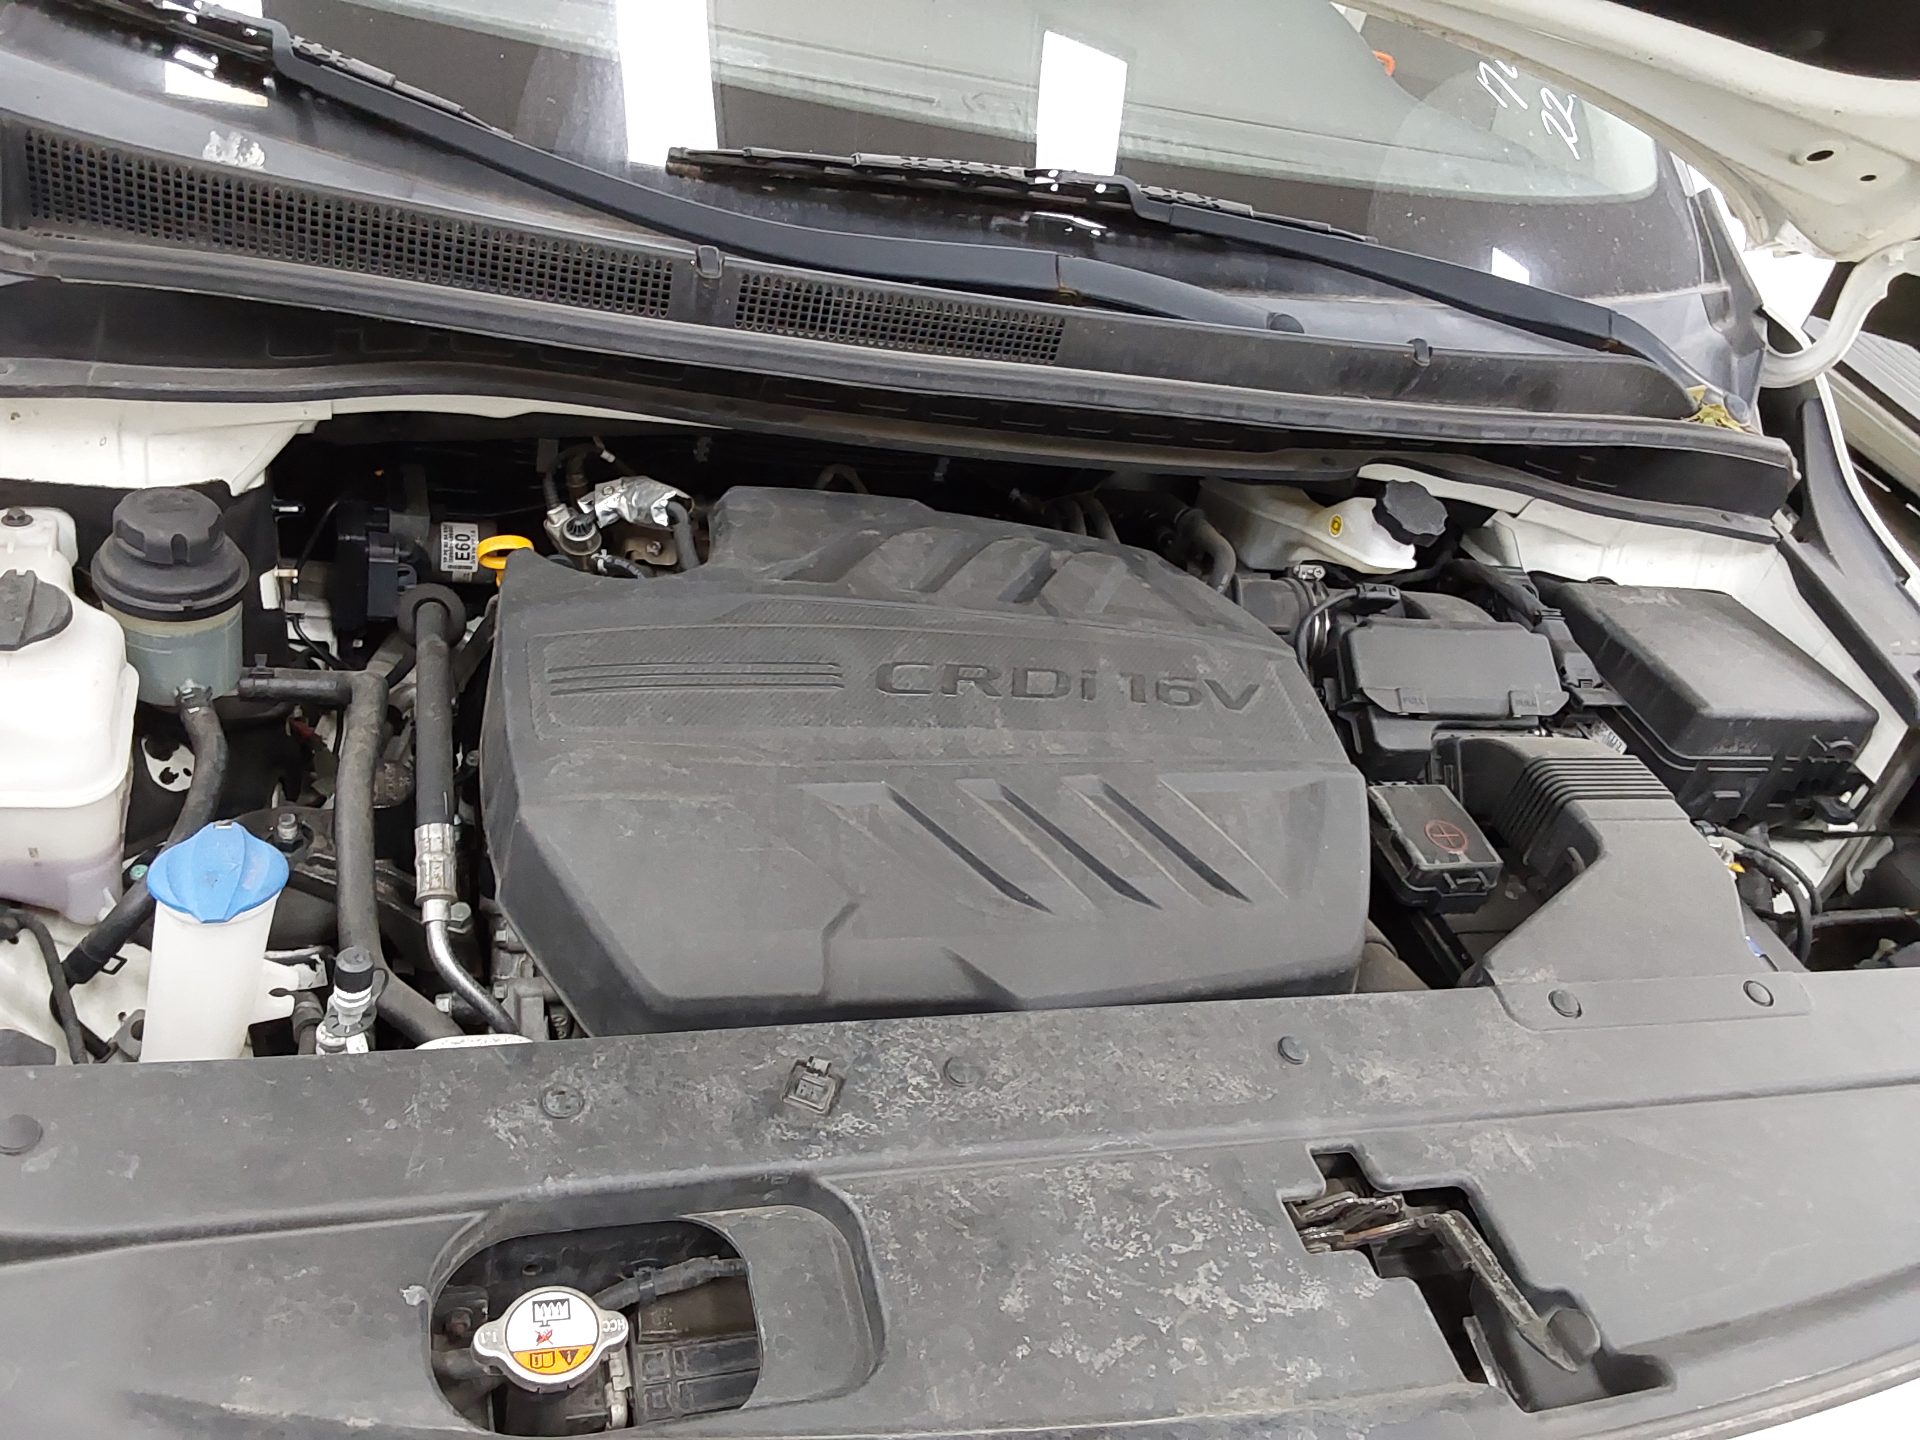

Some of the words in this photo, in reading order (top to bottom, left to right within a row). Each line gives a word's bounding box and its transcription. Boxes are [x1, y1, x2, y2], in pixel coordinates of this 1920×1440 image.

[454, 533, 471, 561] E60
[875, 661, 1098, 702] CRDi
[1119, 669, 1262, 713] 16V
[602, 1318, 627, 1333] HCC
